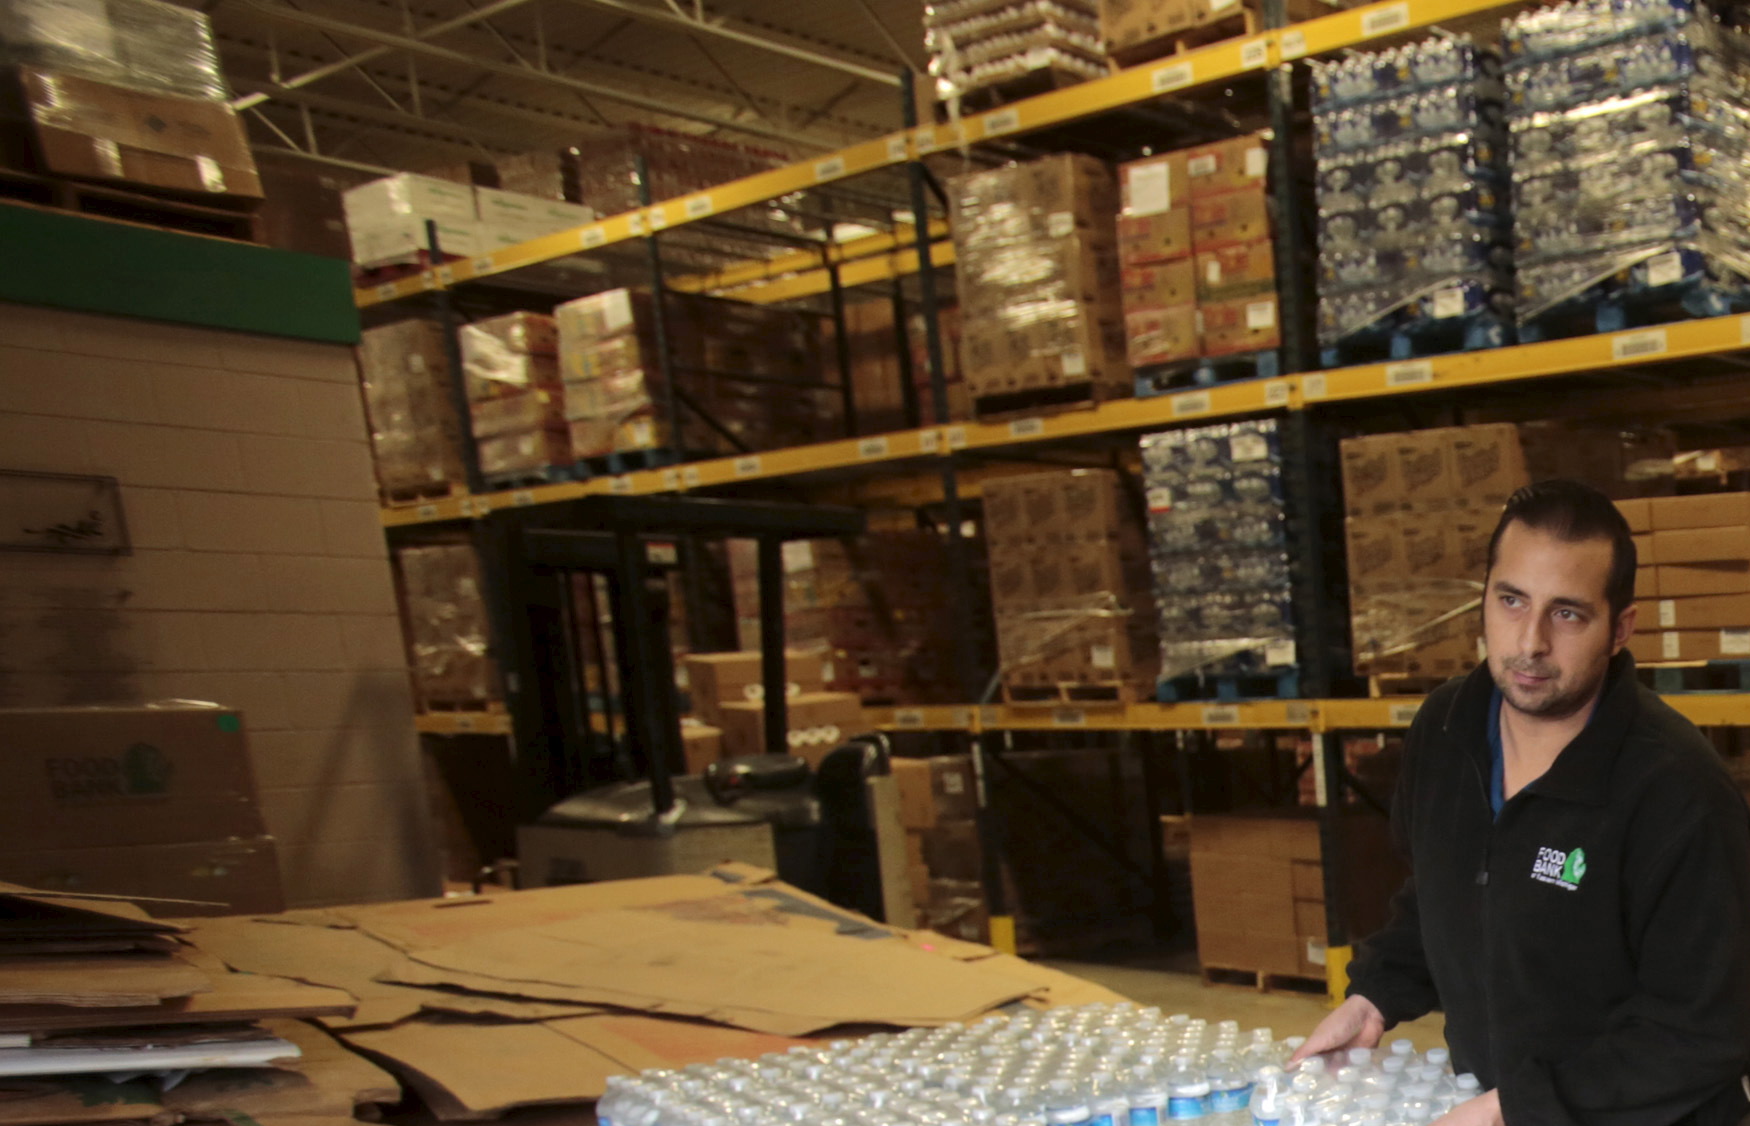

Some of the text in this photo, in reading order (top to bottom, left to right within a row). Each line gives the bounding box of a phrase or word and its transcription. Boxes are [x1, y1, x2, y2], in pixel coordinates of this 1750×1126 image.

[46, 757, 119, 778] FOOD
[1538, 847, 1567, 866] FOOD
[1533, 860, 1563, 879] BANK
